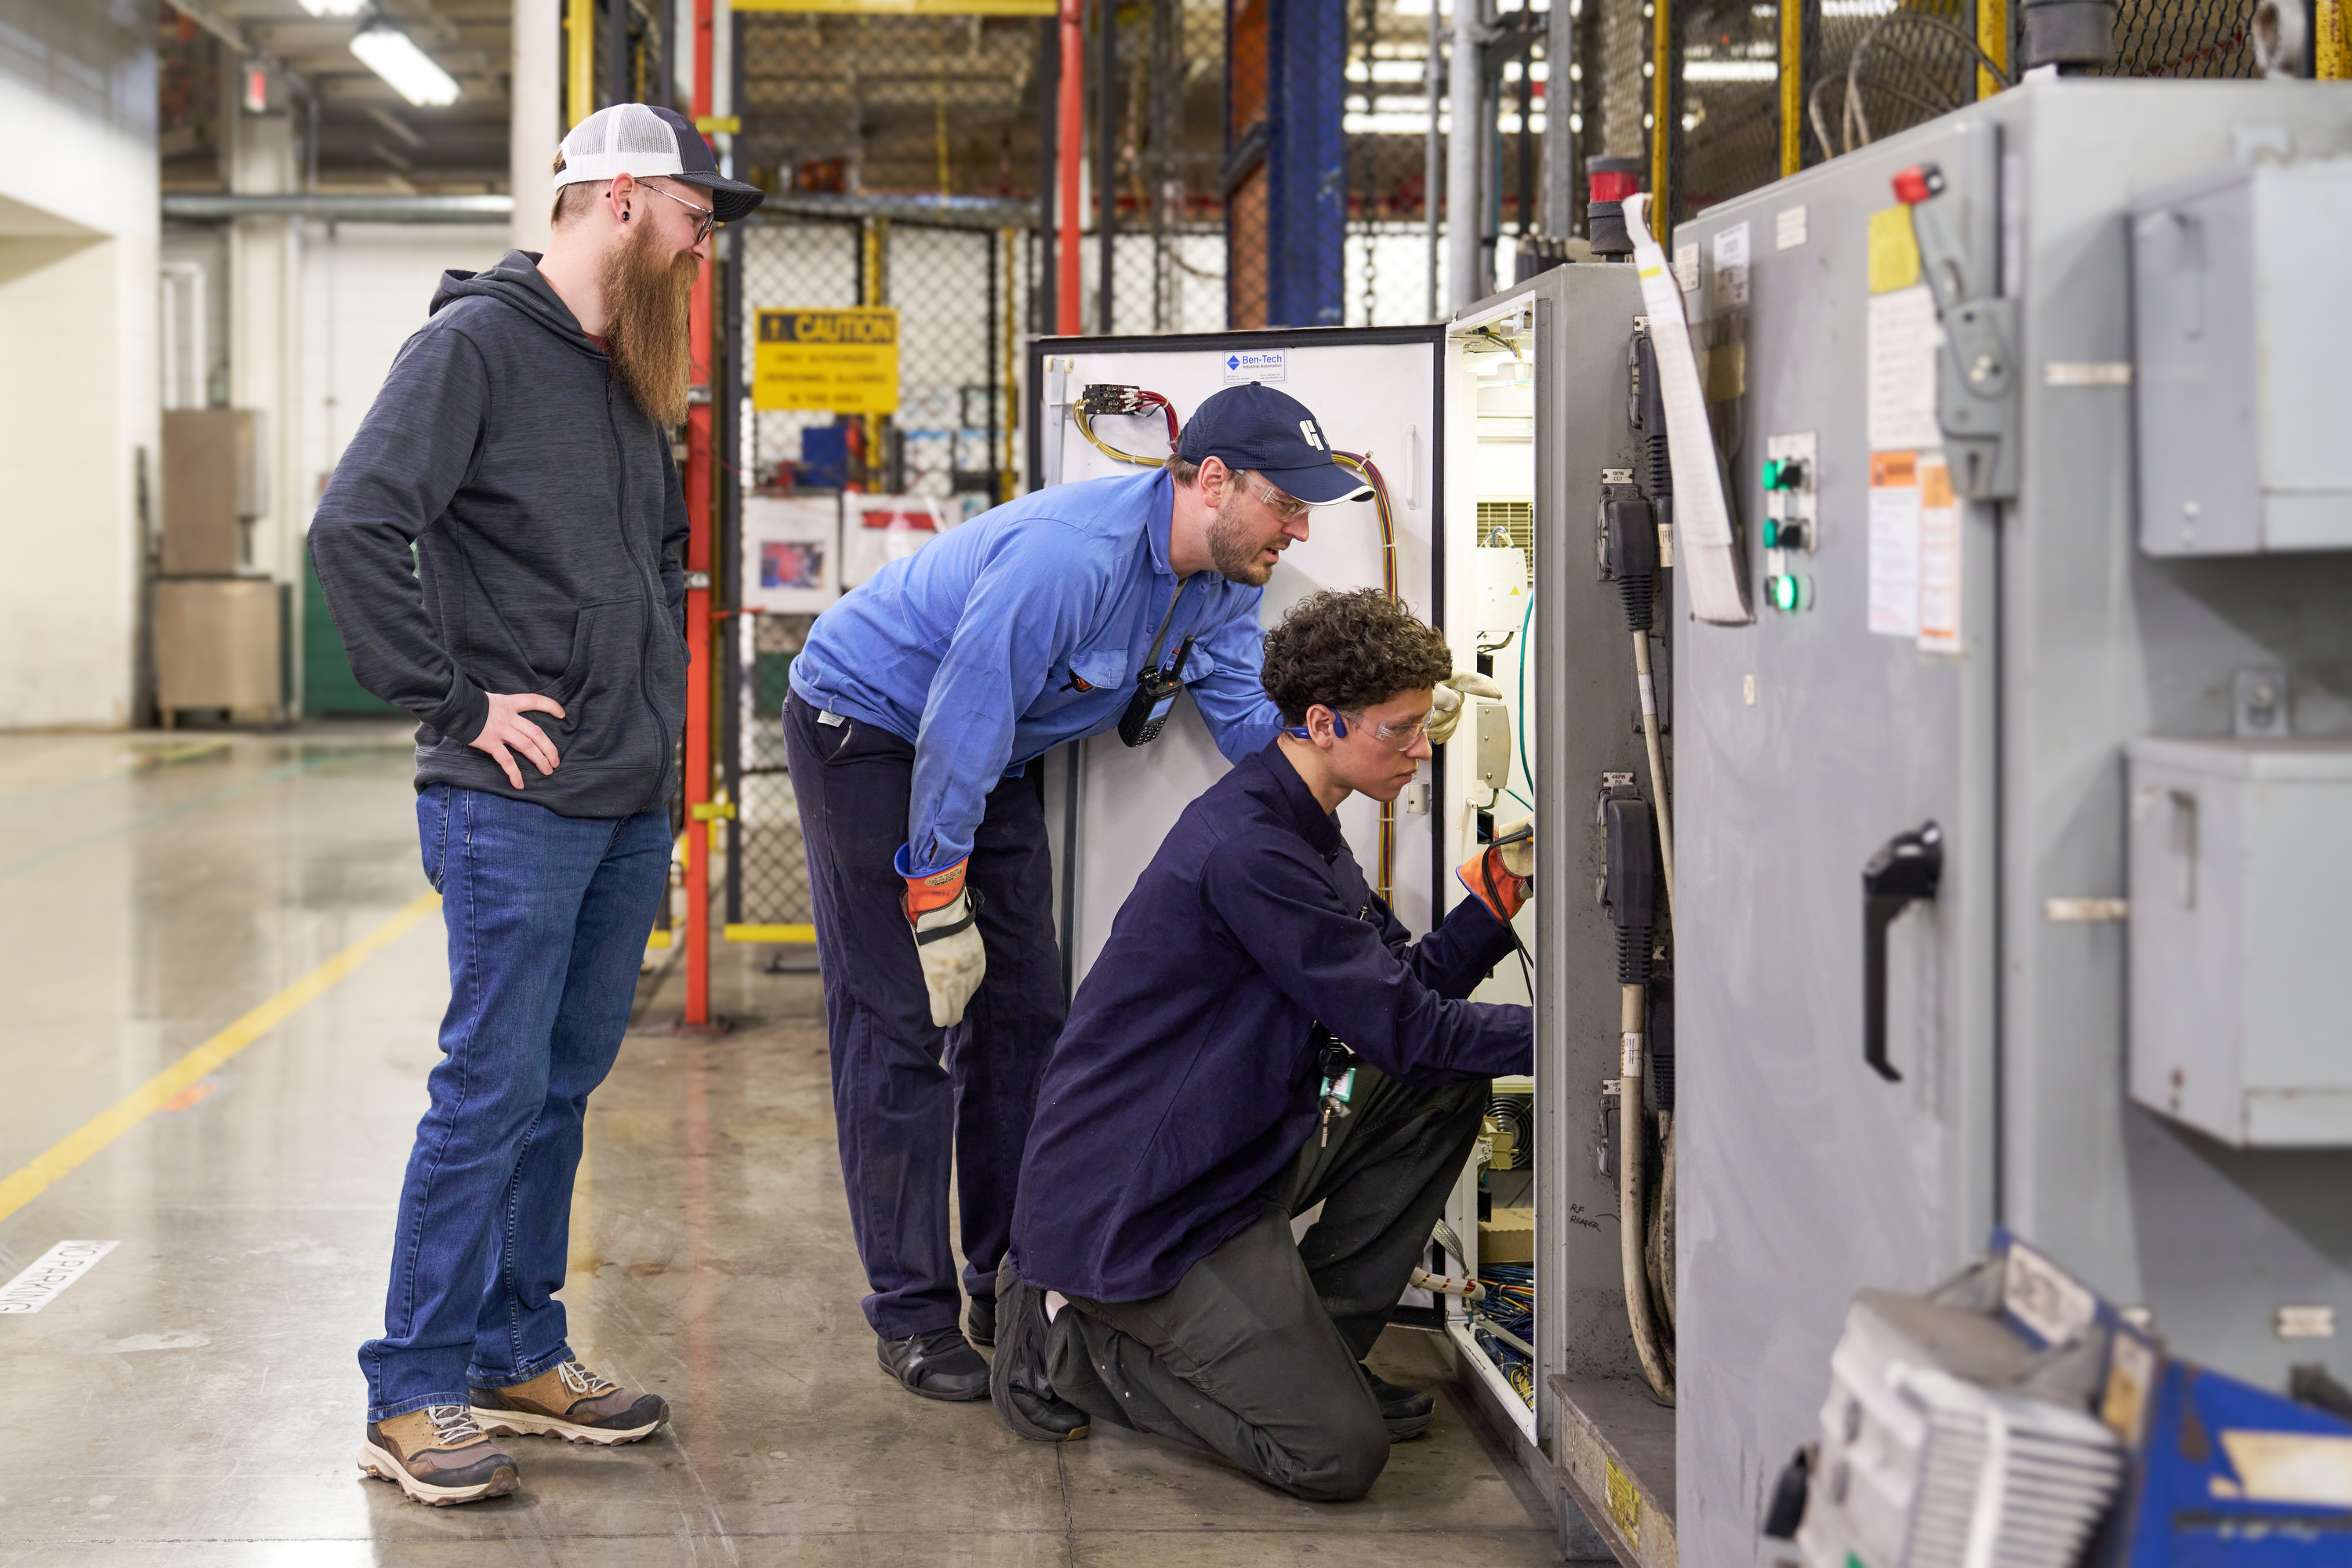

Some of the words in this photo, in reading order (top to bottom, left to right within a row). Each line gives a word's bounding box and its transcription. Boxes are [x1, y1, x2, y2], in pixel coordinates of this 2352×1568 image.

[794, 313, 893, 342] CAUTION
[1242, 354, 1283, 365] Ben-Tech
[1570, 1203, 1585, 1214] RF
[59, 1242, 103, 1258] NO
[0, 1260, 85, 1312] PARKING
